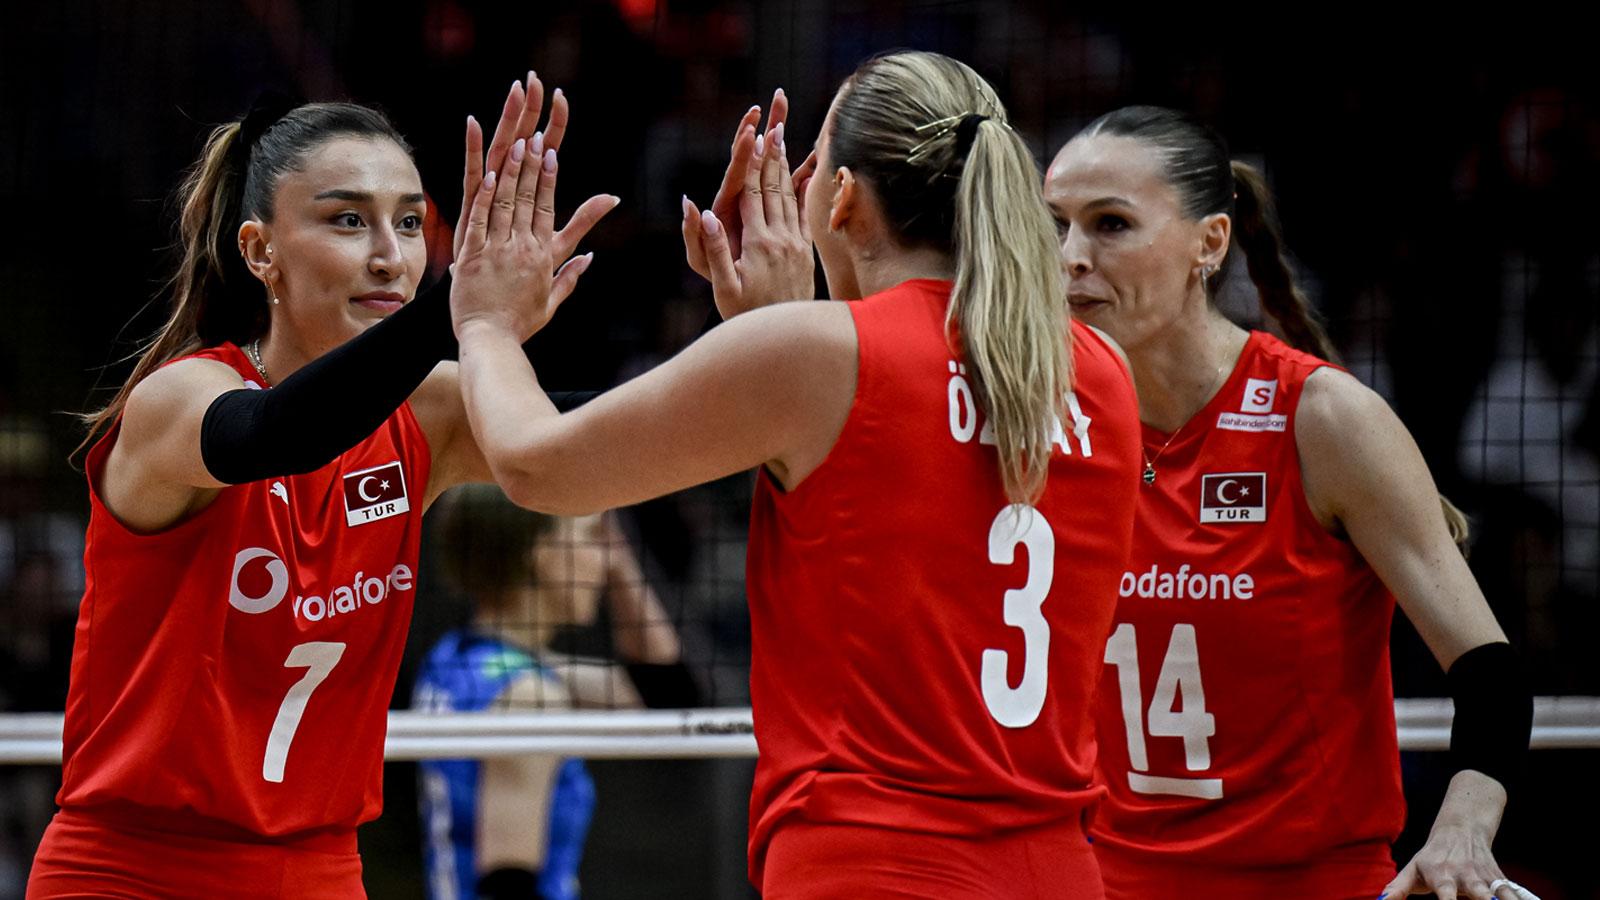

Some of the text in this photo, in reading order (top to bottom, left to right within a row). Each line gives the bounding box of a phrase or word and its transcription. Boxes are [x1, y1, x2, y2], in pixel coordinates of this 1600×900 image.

[948, 360, 1092, 457] ÖAY
[1252, 387, 1271, 406] S
[362, 502, 395, 520] TUR
[1215, 509, 1250, 519] TUR
[292, 563, 412, 622] voafoe
[981, 503, 1055, 728] 3
[262, 641, 346, 783] 7
[1103, 623, 1216, 771] 14
